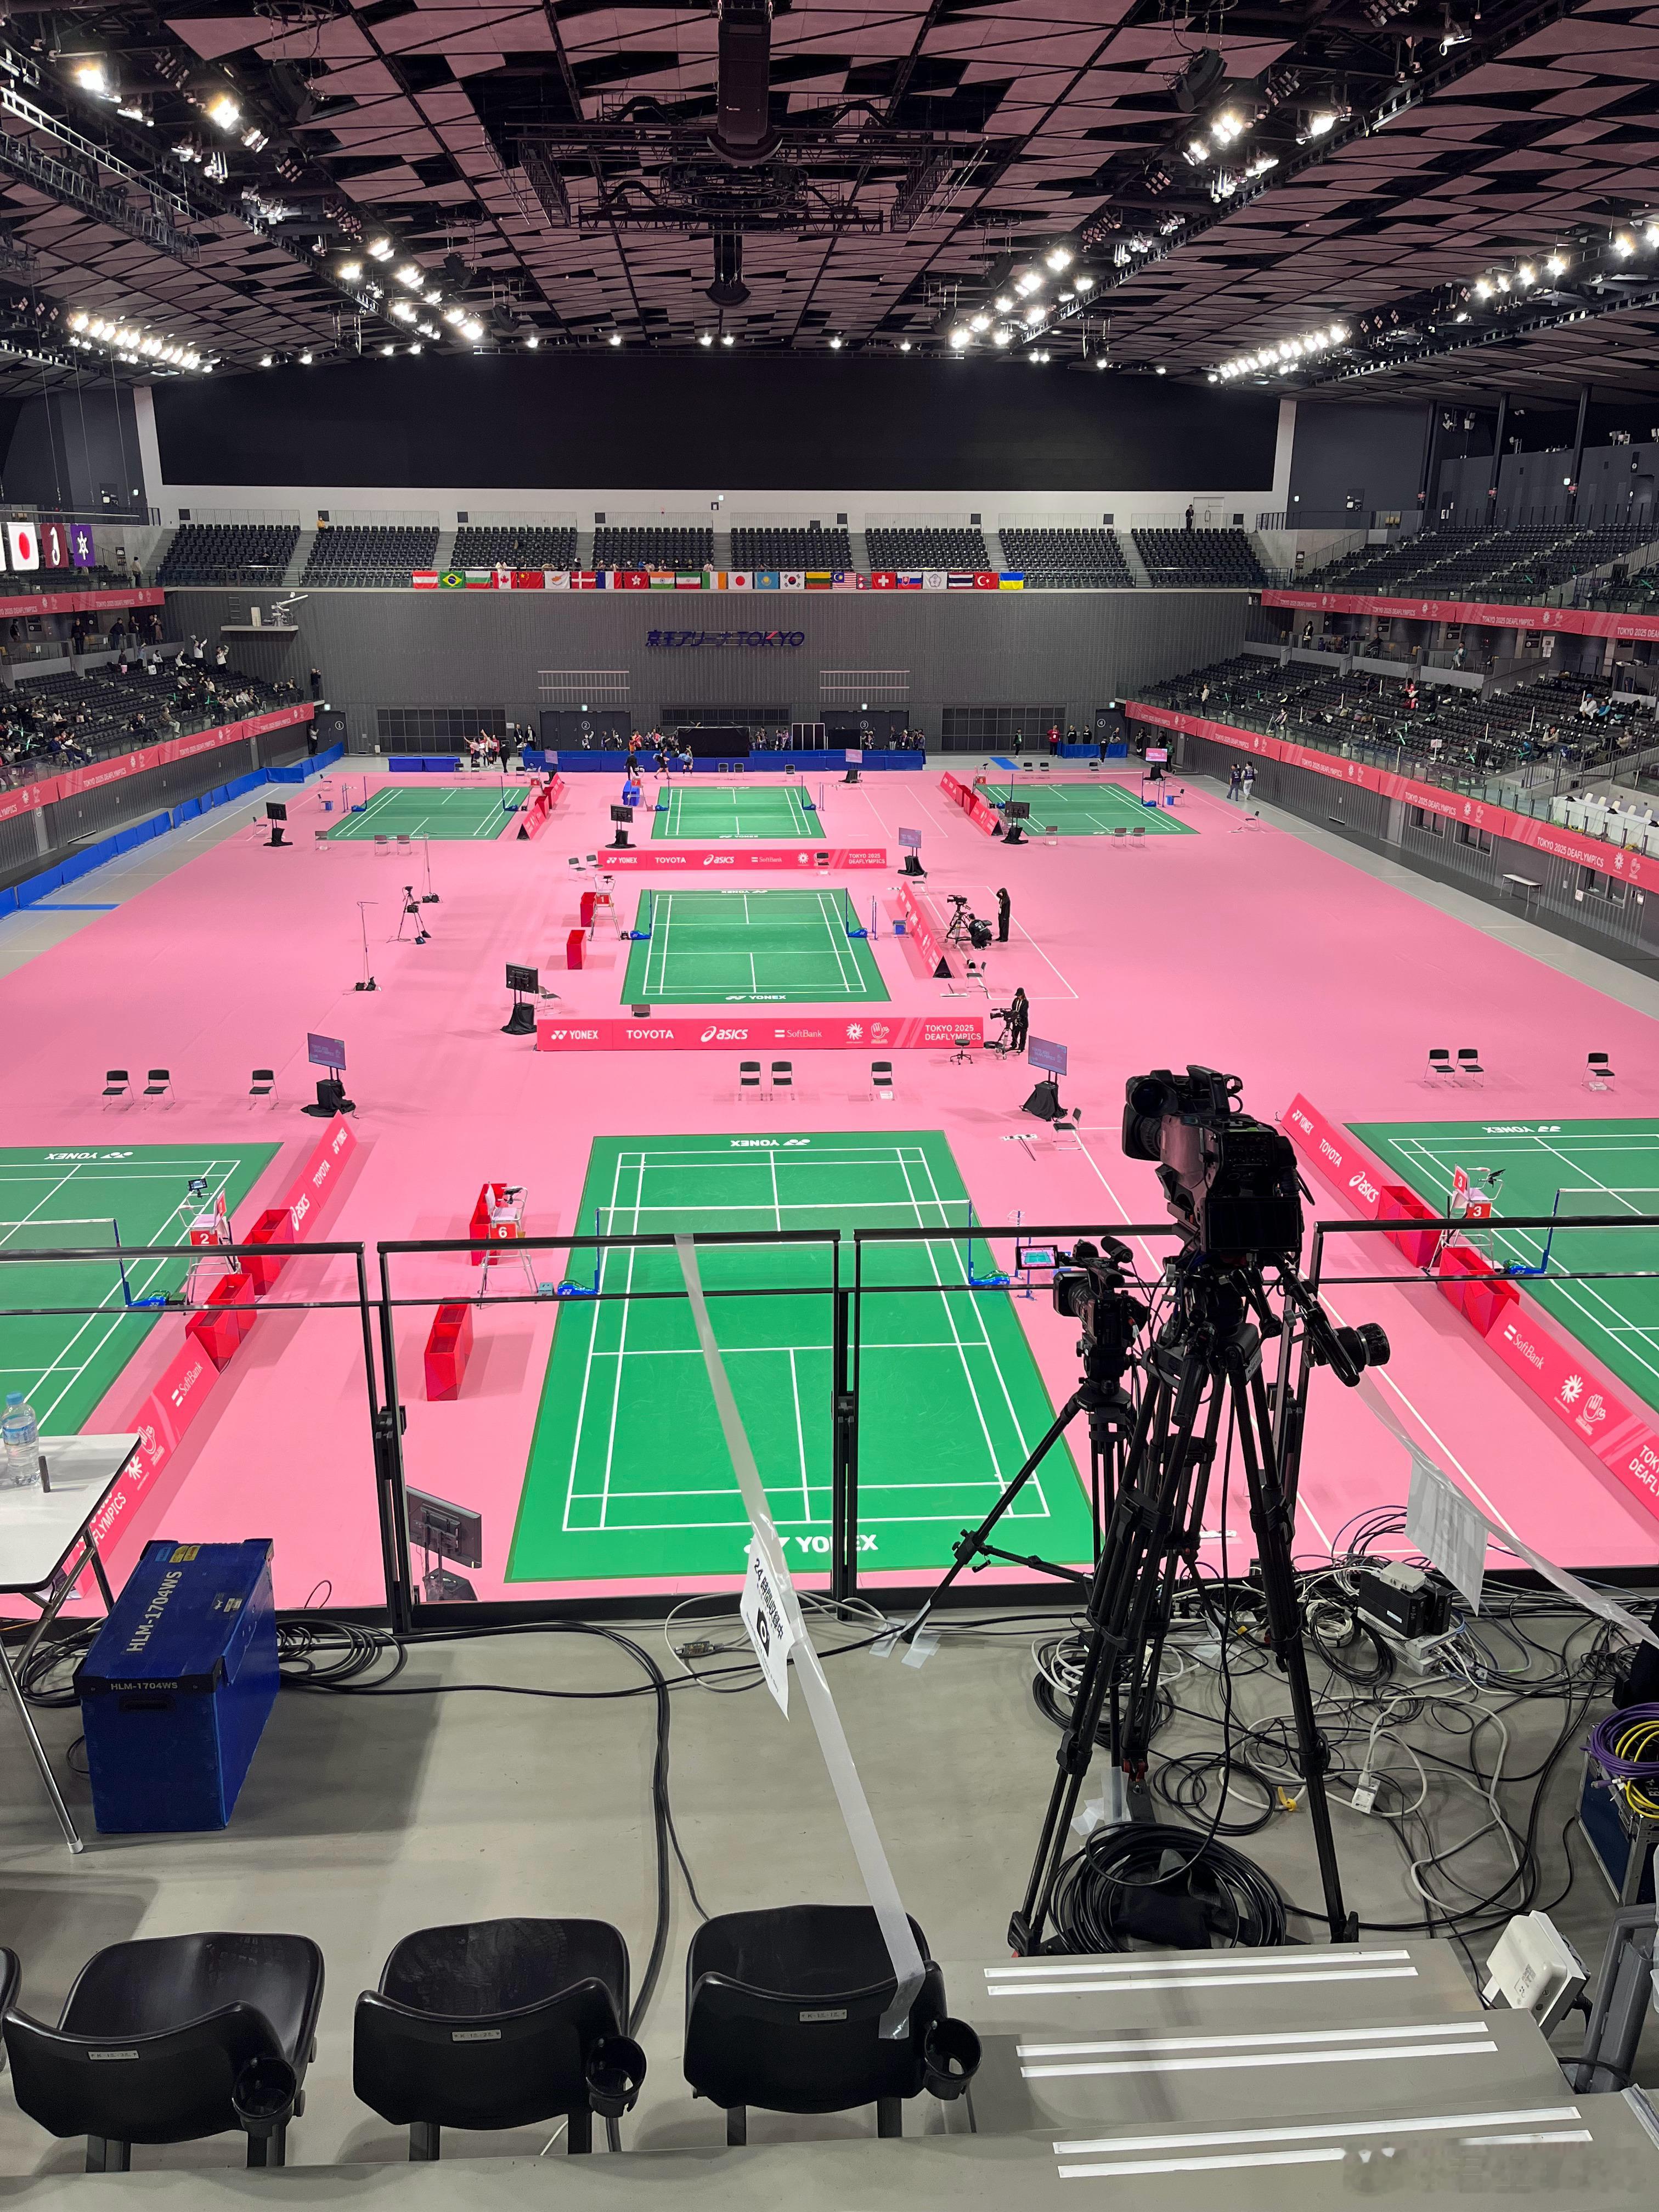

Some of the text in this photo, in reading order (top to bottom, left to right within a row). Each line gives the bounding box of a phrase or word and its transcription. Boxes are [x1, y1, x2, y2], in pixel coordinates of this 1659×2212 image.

[1392, 608, 1415, 616] DEAFLYMPICS
[1482, 615, 1495, 624] TOKYO
[1506, 617, 1534, 627] DEAFLYMPICS
[646, 630, 805, 647] 京王アリーナ TOKYO
[1617, 627, 1633, 636] TOKYO
[1634, 628, 1646, 637] 2025
[1301, 758, 1312, 767] TOKYO
[1320, 762, 1343, 777] DEAFLYMPICS
[83, 768, 126, 787] TOKYO 2025 DEAFLYMPICS
[0, 804, 17, 817] LYMPICS
[1404, 791, 1457, 816] TOKYO 2025 DEAFLYMPICS
[1537, 836, 1604, 867] TOKYO 2025 DEAFLYMPICS
[569, 1030, 599, 1040] YONEX
[626, 1030, 674, 1039] TOYOTA
[787, 1029, 822, 1037] SoftBank
[336, 1127, 348, 1147] YONEX
[1299, 1115, 1314, 1136] YONEX
[1319, 1138, 1342, 1167] TOYOTA
[312, 1159, 331, 1188] TOYOTA
[1458, 1176, 1463, 1188] 3
[1473, 1206, 1482, 1217] 3
[200, 1233, 210, 1244] 2
[498, 1227, 507, 1238] 6
[1513, 1334, 1545, 1369] SoftBank
[179, 1361, 203, 1396] SoftBank
[1639, 1444, 1659, 1473] TOK
[93, 1492, 126, 1545] FLYMPICS
[795, 1534, 879, 1553] YOX
[126, 1571, 183, 1652] HLM-1704WS
